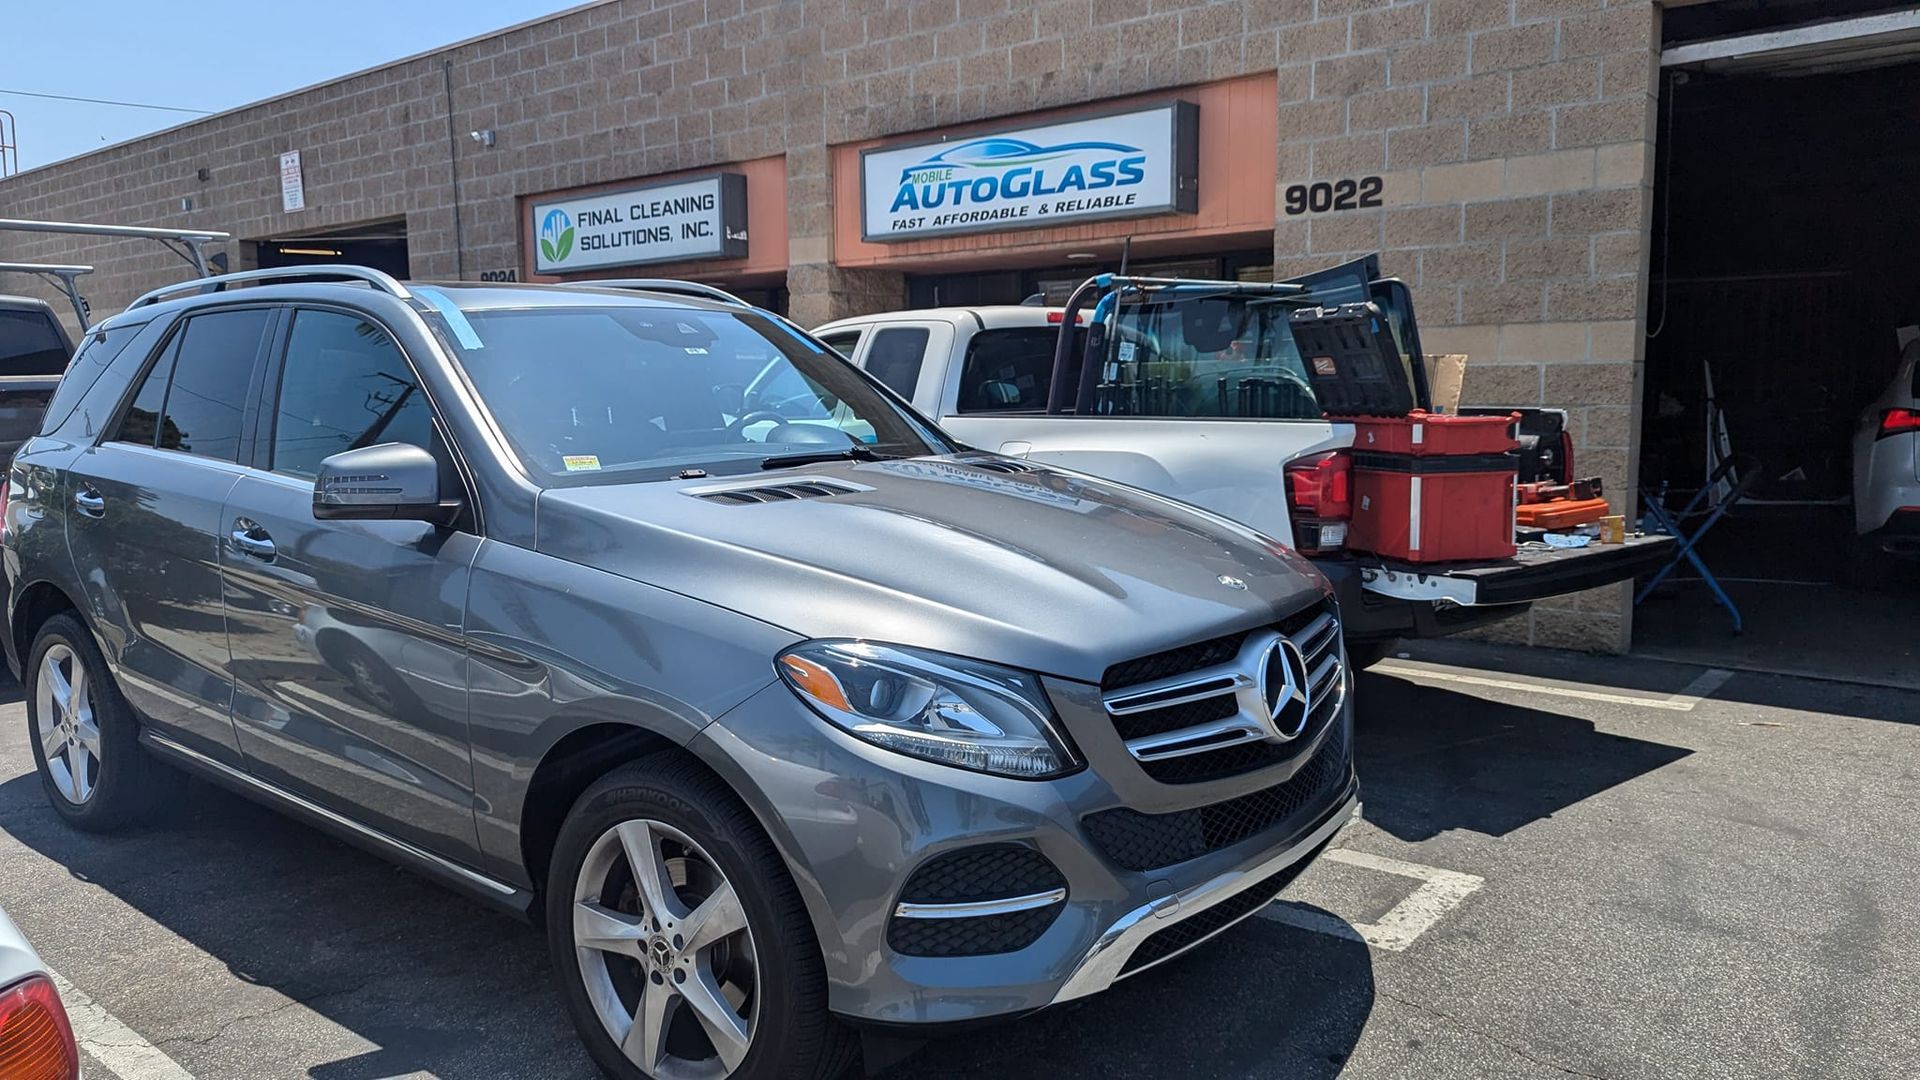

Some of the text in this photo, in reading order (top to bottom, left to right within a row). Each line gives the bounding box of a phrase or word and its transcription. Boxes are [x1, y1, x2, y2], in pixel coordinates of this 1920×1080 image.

[911, 169, 952, 184] MOBILE
[577, 194, 714, 228] FINAL CLEANING
[892, 193, 1137, 230] FAST AFFORDABLE & RELIABLE
[1285, 176, 1383, 215] 9022
[580, 221, 714, 251] SOLUTIONS, INC.
